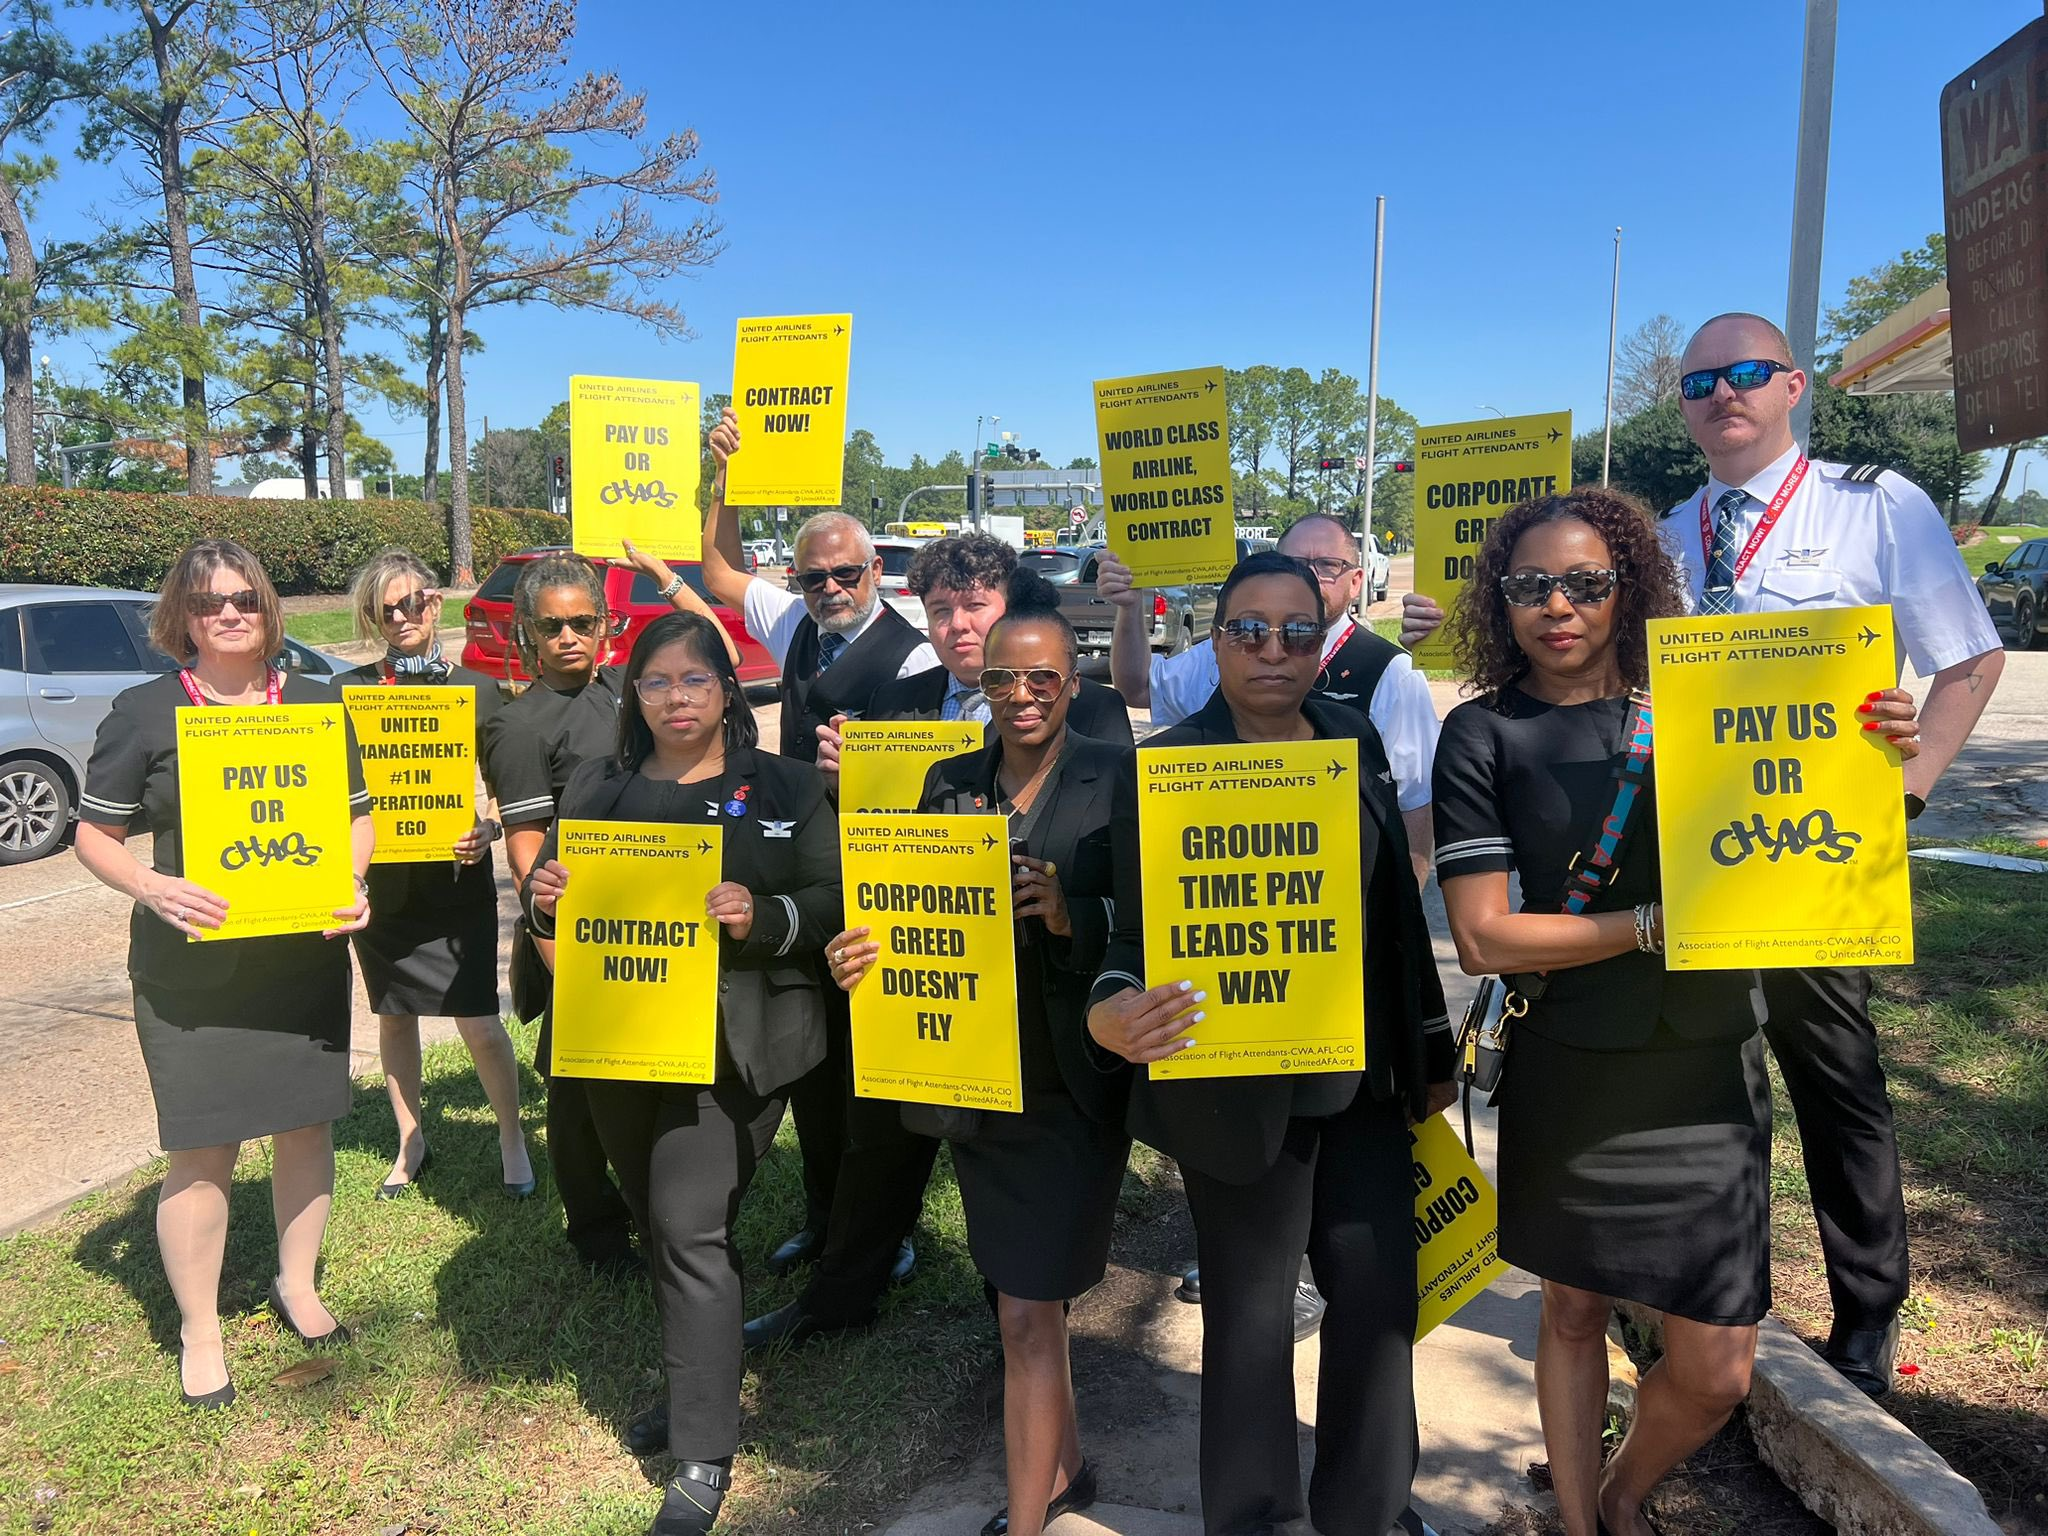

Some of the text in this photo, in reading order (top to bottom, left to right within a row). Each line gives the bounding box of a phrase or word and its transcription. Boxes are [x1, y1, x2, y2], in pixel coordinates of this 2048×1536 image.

[1967, 226, 2015, 272] BEFORE
[1973, 260, 2025, 304] PUSHING
[1989, 298, 2021, 332] CALL
[742, 323, 812, 333] UNITED AIRLINES
[741, 333, 828, 343] FLIGHT ATTENDANTS
[579, 383, 658, 394] UNITED AIRLINES
[745, 386, 833, 407] CONTRACT
[1099, 381, 1179, 397] UNITED AIRLINES
[579, 394, 676, 406] FLIGHT ATTENDANTS
[1100, 391, 1199, 409] FLIGHT ATTENDANTS
[764, 414, 810, 433] NOW!
[605, 424, 669, 446] PAY US
[1105, 421, 1220, 451] WORLD CLASS
[1421, 429, 1516, 446] UNITED AIRLINES
[1421, 440, 1540, 460] FLIGHT ATTENDANTS
[624, 452, 650, 471] OR
[1132, 456, 1197, 480] AIRLINE,
[599, 479, 679, 509] CHAOS
[1110, 485, 1225, 512] WORLD CLASS
[1427, 475, 1557, 510] CORPORATE
[1771, 474, 1799, 512] NO MORE
[1127, 517, 1212, 542] CONTRACT
[1659, 626, 1809, 646] UNITED AIRLINES
[1660, 644, 1846, 665] FLIGHT ATTENDANTS
[184, 715, 290, 725] UNITED AIRLINES
[380, 717, 440, 733] UNITED
[1713, 702, 1837, 744] PAY US
[185, 726, 314, 738] FLIGHT ATTENDANTS
[845, 730, 934, 740] UNITED AIRLINES
[845, 743, 955, 753] FLIGHT ATTENDANTS
[1148, 758, 1284, 775] UNITED AIRLINES
[223, 764, 307, 791] PAY US
[389, 769, 431, 785] #1 IN
[1149, 775, 1316, 794] FLIGHT ATTENDANTS
[1752, 758, 1803, 796] OR
[250, 799, 284, 824] OR
[370, 794, 464, 811] PERATIONAL
[396, 820, 427, 836] EGO
[847, 827, 949, 839] UNITED AIRLINES
[565, 832, 666, 844] UNITED AIRLINES
[1182, 821, 1318, 861] GROUND
[1710, 809, 1862, 867] CHAOS
[220, 832, 323, 871] CHAOS
[565, 846, 690, 859] FLIGHT ATTENDANTS
[848, 843, 975, 856] FLIGHT ATTENDANTS
[857, 882, 997, 917] CORPORATE
[1178, 870, 1325, 910] TIME PAY
[243, 917, 261, 926] Flight
[575, 917, 699, 948] CONTRACT
[890, 925, 965, 958] GREED
[1170, 919, 1337, 959] LEADS THE
[1677, 940, 1730, 951] Association
[1733, 939, 1743, 948] of
[1745, 938, 1770, 950] Flight
[1830, 948, 1902, 960] UnitedAFA.org
[603, 956, 668, 984] NOW!
[882, 967, 979, 1002] DOESN'T
[1218, 969, 1291, 1005] WAY
[917, 1012, 953, 1042] FLY
[559, 1056, 594, 1064] Association
[595, 1057, 604, 1065] of
[604, 1057, 621, 1067] Flight
[1208, 1050, 1218, 1060] of
[1219, 1049, 1241, 1061] Flight
[1293, 1057, 1355, 1068] UnitedAFA.org
[658, 1069, 706, 1080] UnitedAFA.org
[861, 1074, 897, 1085] Association
[898, 1077, 906, 1085] of
[906, 1078, 924, 1088] Flight
[963, 1095, 1013, 1108] UnitedAFA.org
[1439, 1264, 1482, 1302] AIRLINES
